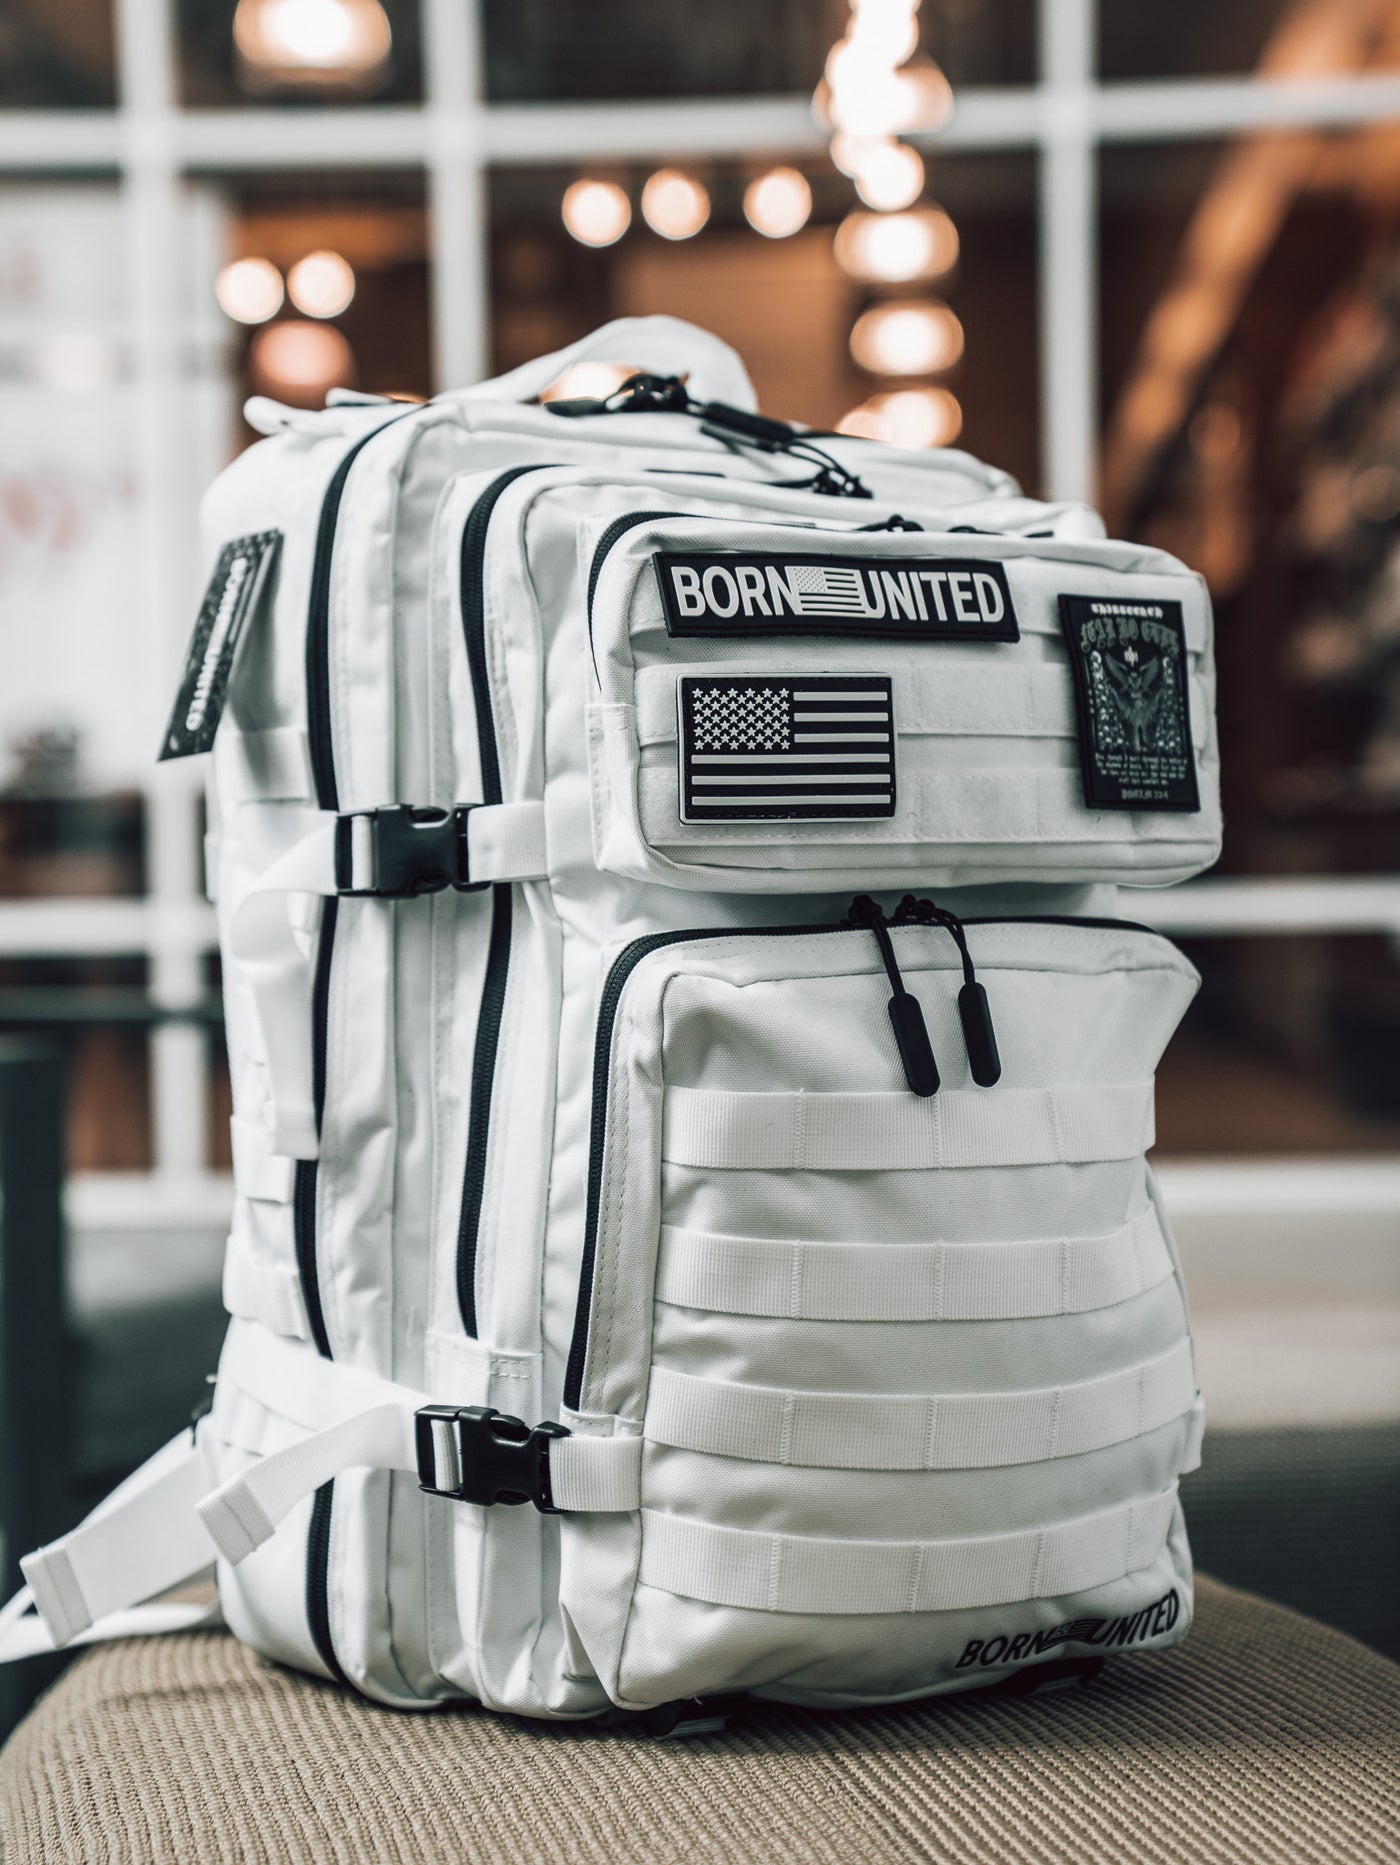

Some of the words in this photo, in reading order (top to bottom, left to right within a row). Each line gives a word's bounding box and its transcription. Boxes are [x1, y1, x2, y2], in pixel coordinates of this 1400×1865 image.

[670, 566, 800, 618] BORN
[858, 570, 1004, 623] UNITED
[186, 645, 221, 731] UNITED
[955, 1630, 1051, 1668] BORN
[1088, 1587, 1180, 1647] UNITED
